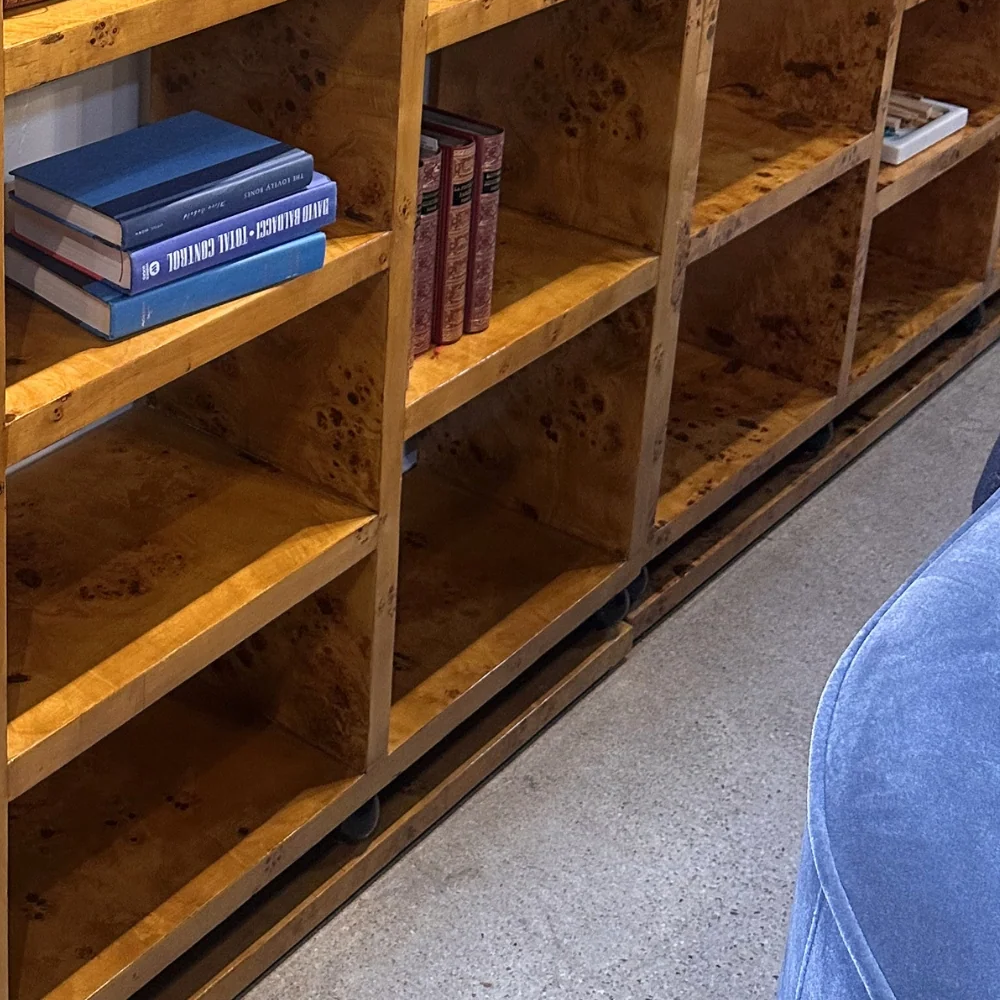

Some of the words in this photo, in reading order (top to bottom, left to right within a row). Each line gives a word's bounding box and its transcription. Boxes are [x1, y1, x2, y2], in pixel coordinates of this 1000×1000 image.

[265, 177, 291, 192] LOVELY
[293, 172, 304, 182] THE
[244, 188, 264, 200] BONES
[302, 197, 330, 223] DAVID
[256, 207, 300, 240] BALDACCI
[218, 226, 248, 254] TOTAL
[166, 237, 215, 273] CONTROL
